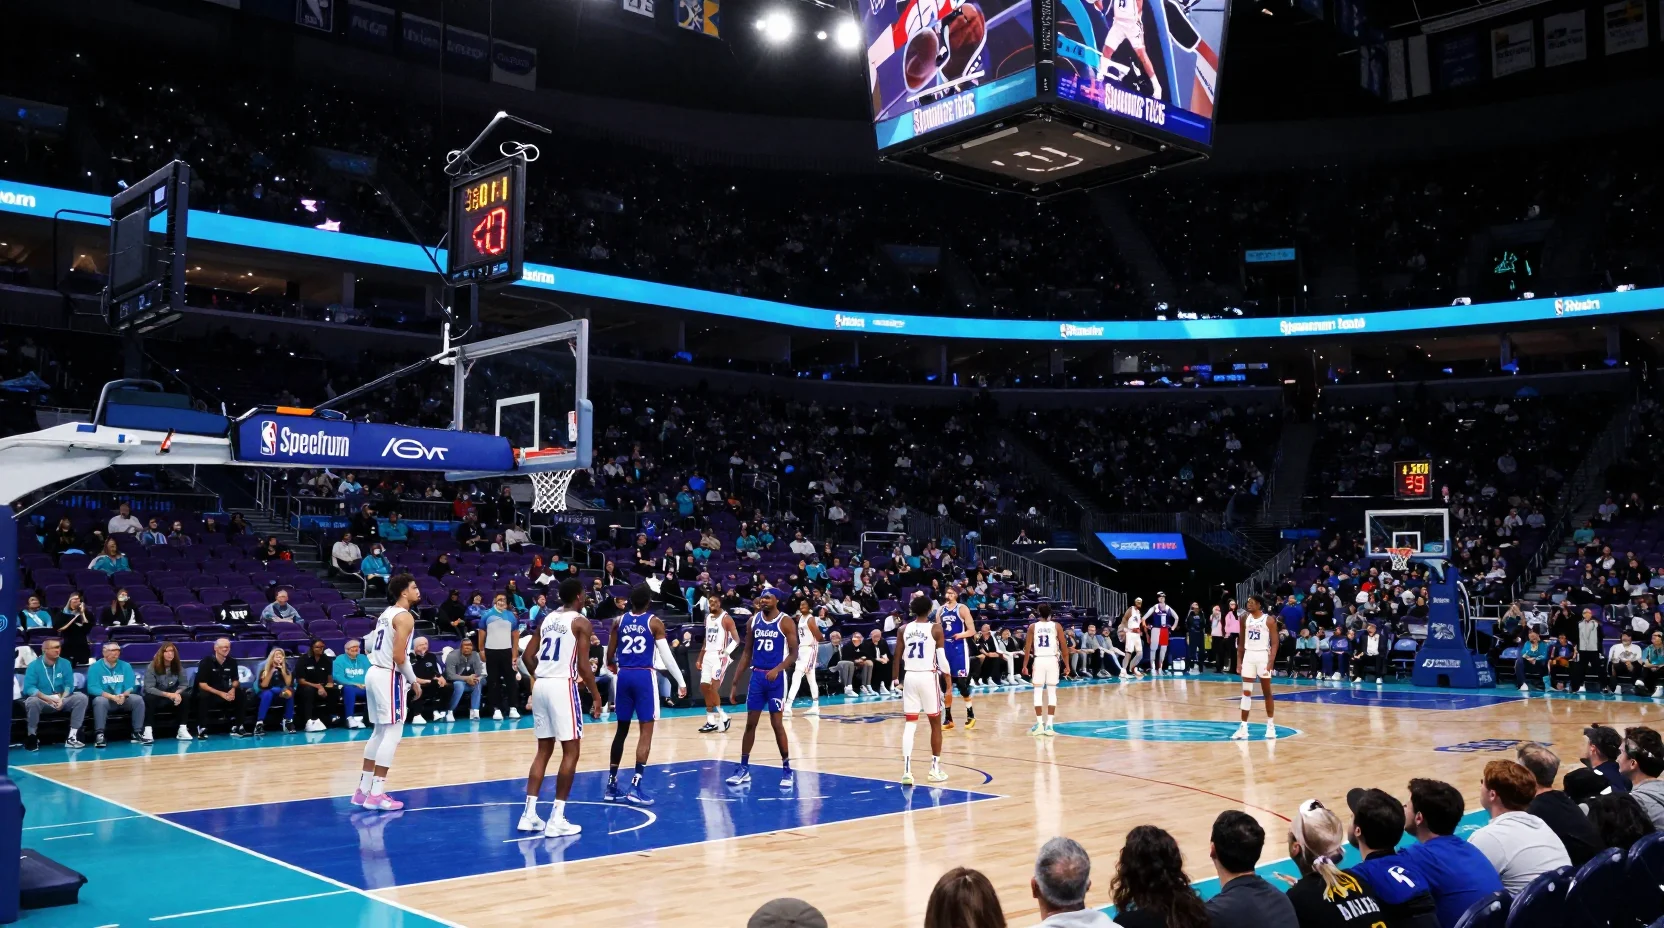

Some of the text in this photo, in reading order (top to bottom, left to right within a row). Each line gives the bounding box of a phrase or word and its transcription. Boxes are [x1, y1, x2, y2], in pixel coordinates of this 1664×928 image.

[540, 637, 561, 662] 21
[621, 635, 647, 654] 23
[907, 641, 925, 659] 71
